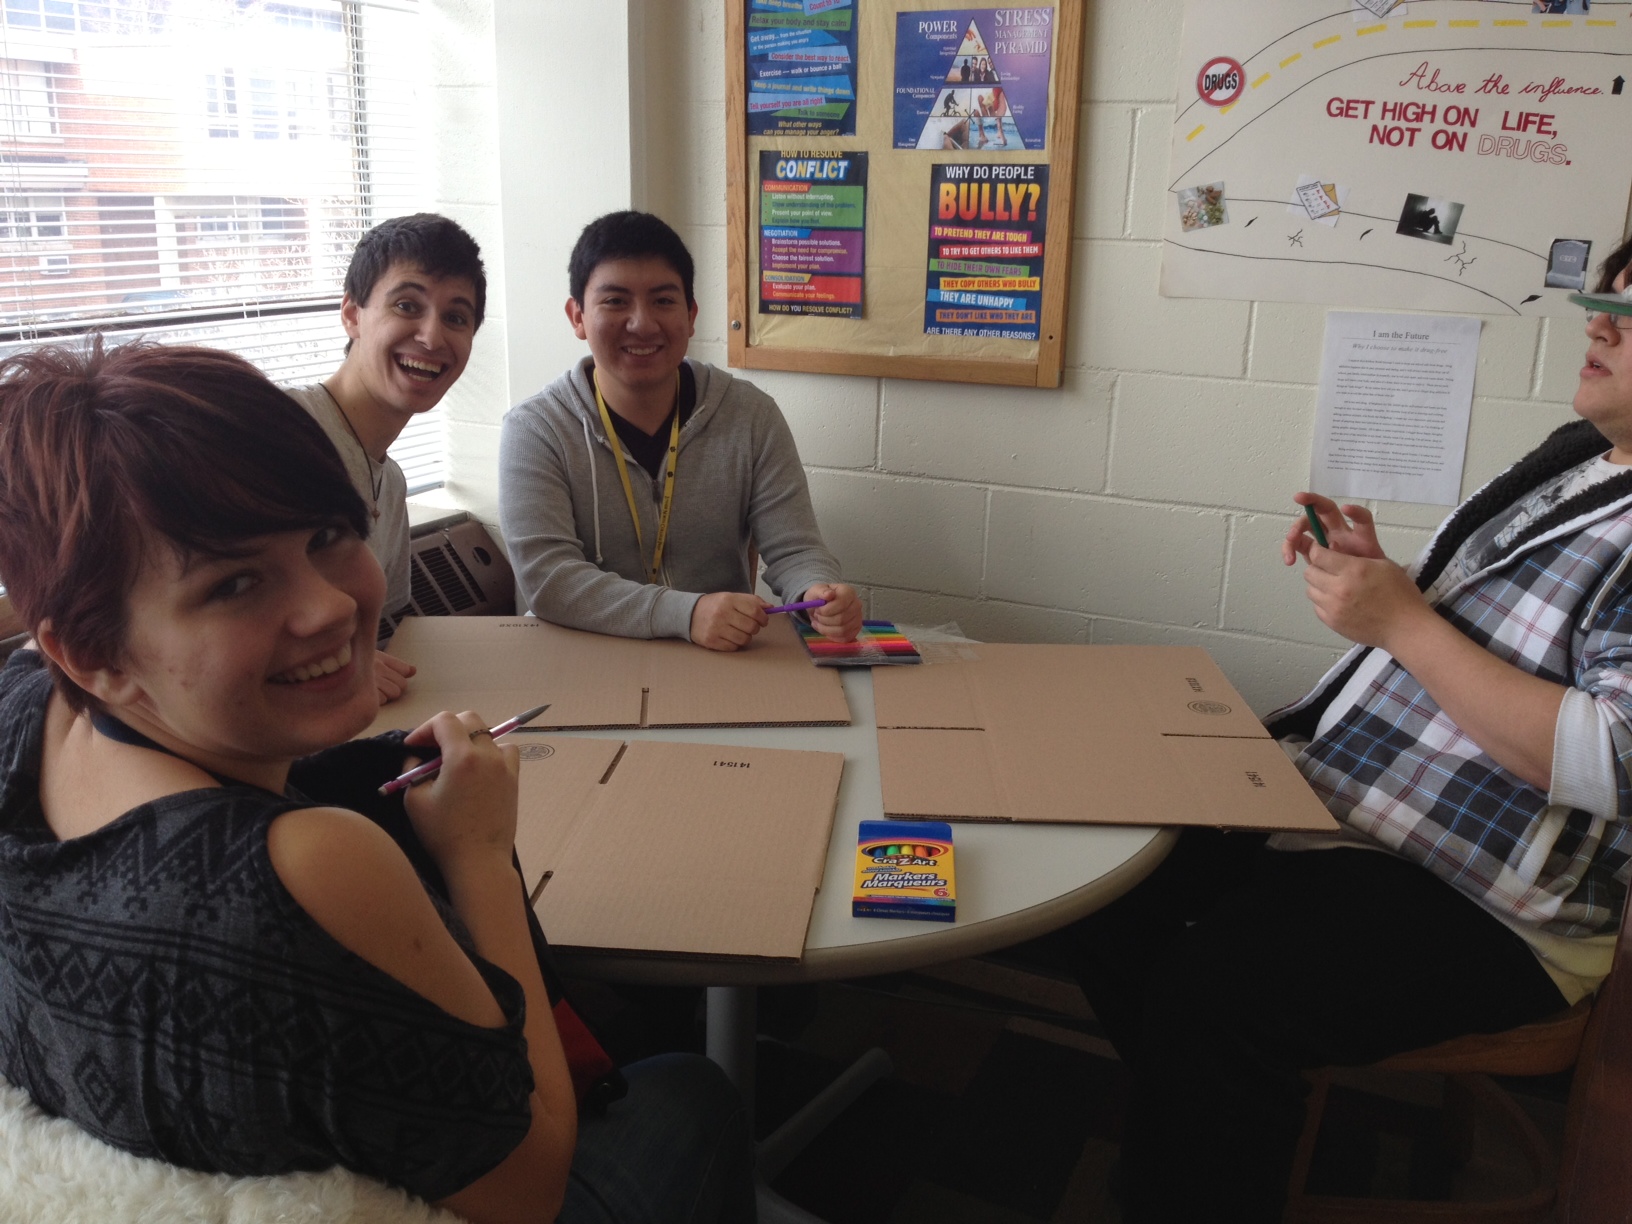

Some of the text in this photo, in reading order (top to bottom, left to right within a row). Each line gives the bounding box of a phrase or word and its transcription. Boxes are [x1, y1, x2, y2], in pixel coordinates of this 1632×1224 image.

[771, 18, 784, 26] your
[786, 17, 801, 26] body
[803, 18, 815, 26] and
[816, 19, 829, 28] stay
[995, 9, 1050, 26] STRESS
[918, 20, 958, 33] POWER
[926, 32, 958, 41] Components
[995, 29, 1048, 40] MANAGEMENT
[994, 40, 1048, 54] PYRAMID
[771, 52, 794, 60] Consider
[760, 70, 782, 78] Exercise
[1204, 70, 1238, 92] DRUGS
[1399, 62, 1604, 102] Above the influence.
[750, 102, 760, 110] Tell
[760, 101, 781, 110] yourself
[810, 98, 823, 106] right
[1326, 96, 1558, 140] GET HIGH ON LIFE,
[1368, 124, 1572, 166] NOT ON DRUGS.
[781, 150, 842, 158] HOW TO RESOLVE
[776, 160, 848, 178] CONFLICT
[946, 166, 1034, 179] WHY DO PEOPLE
[764, 184, 808, 192] COMMUNICATION
[938, 182, 1040, 221] BULLY?
[934, 227, 1028, 242] TO PRETEND THEY ARE TOUGH
[942, 248, 950, 256] TO
[1002, 246, 1010, 254] TO
[1010, 246, 1022, 254] LIKE
[1022, 246, 1038, 254] THEM
[937, 260, 1022, 276] TO HIDE THEIR OWN FEARS
[943, 280, 1036, 288] THEY COPY OTHERS WHO BULLY
[940, 291, 1014, 308] THEY ARE UNHAPPY
[826, 306, 852, 314] CONFLICT?
[956, 312, 974, 320] DON'T
[974, 312, 987, 320] LIKE
[990, 312, 1003, 320] WHO
[1005, 312, 1019, 320] THEY
[1022, 312, 1032, 320] ARE
[942, 328, 962, 336] THERE
[964, 328, 978, 336] ANY
[979, 330, 1000, 338] OTHER
[1002, 331, 1036, 340] REASONS?
[1405, 332, 1430, 340] Future
[874, 873, 936, 881] Markers
[862, 880, 945, 888] Marqueurs
